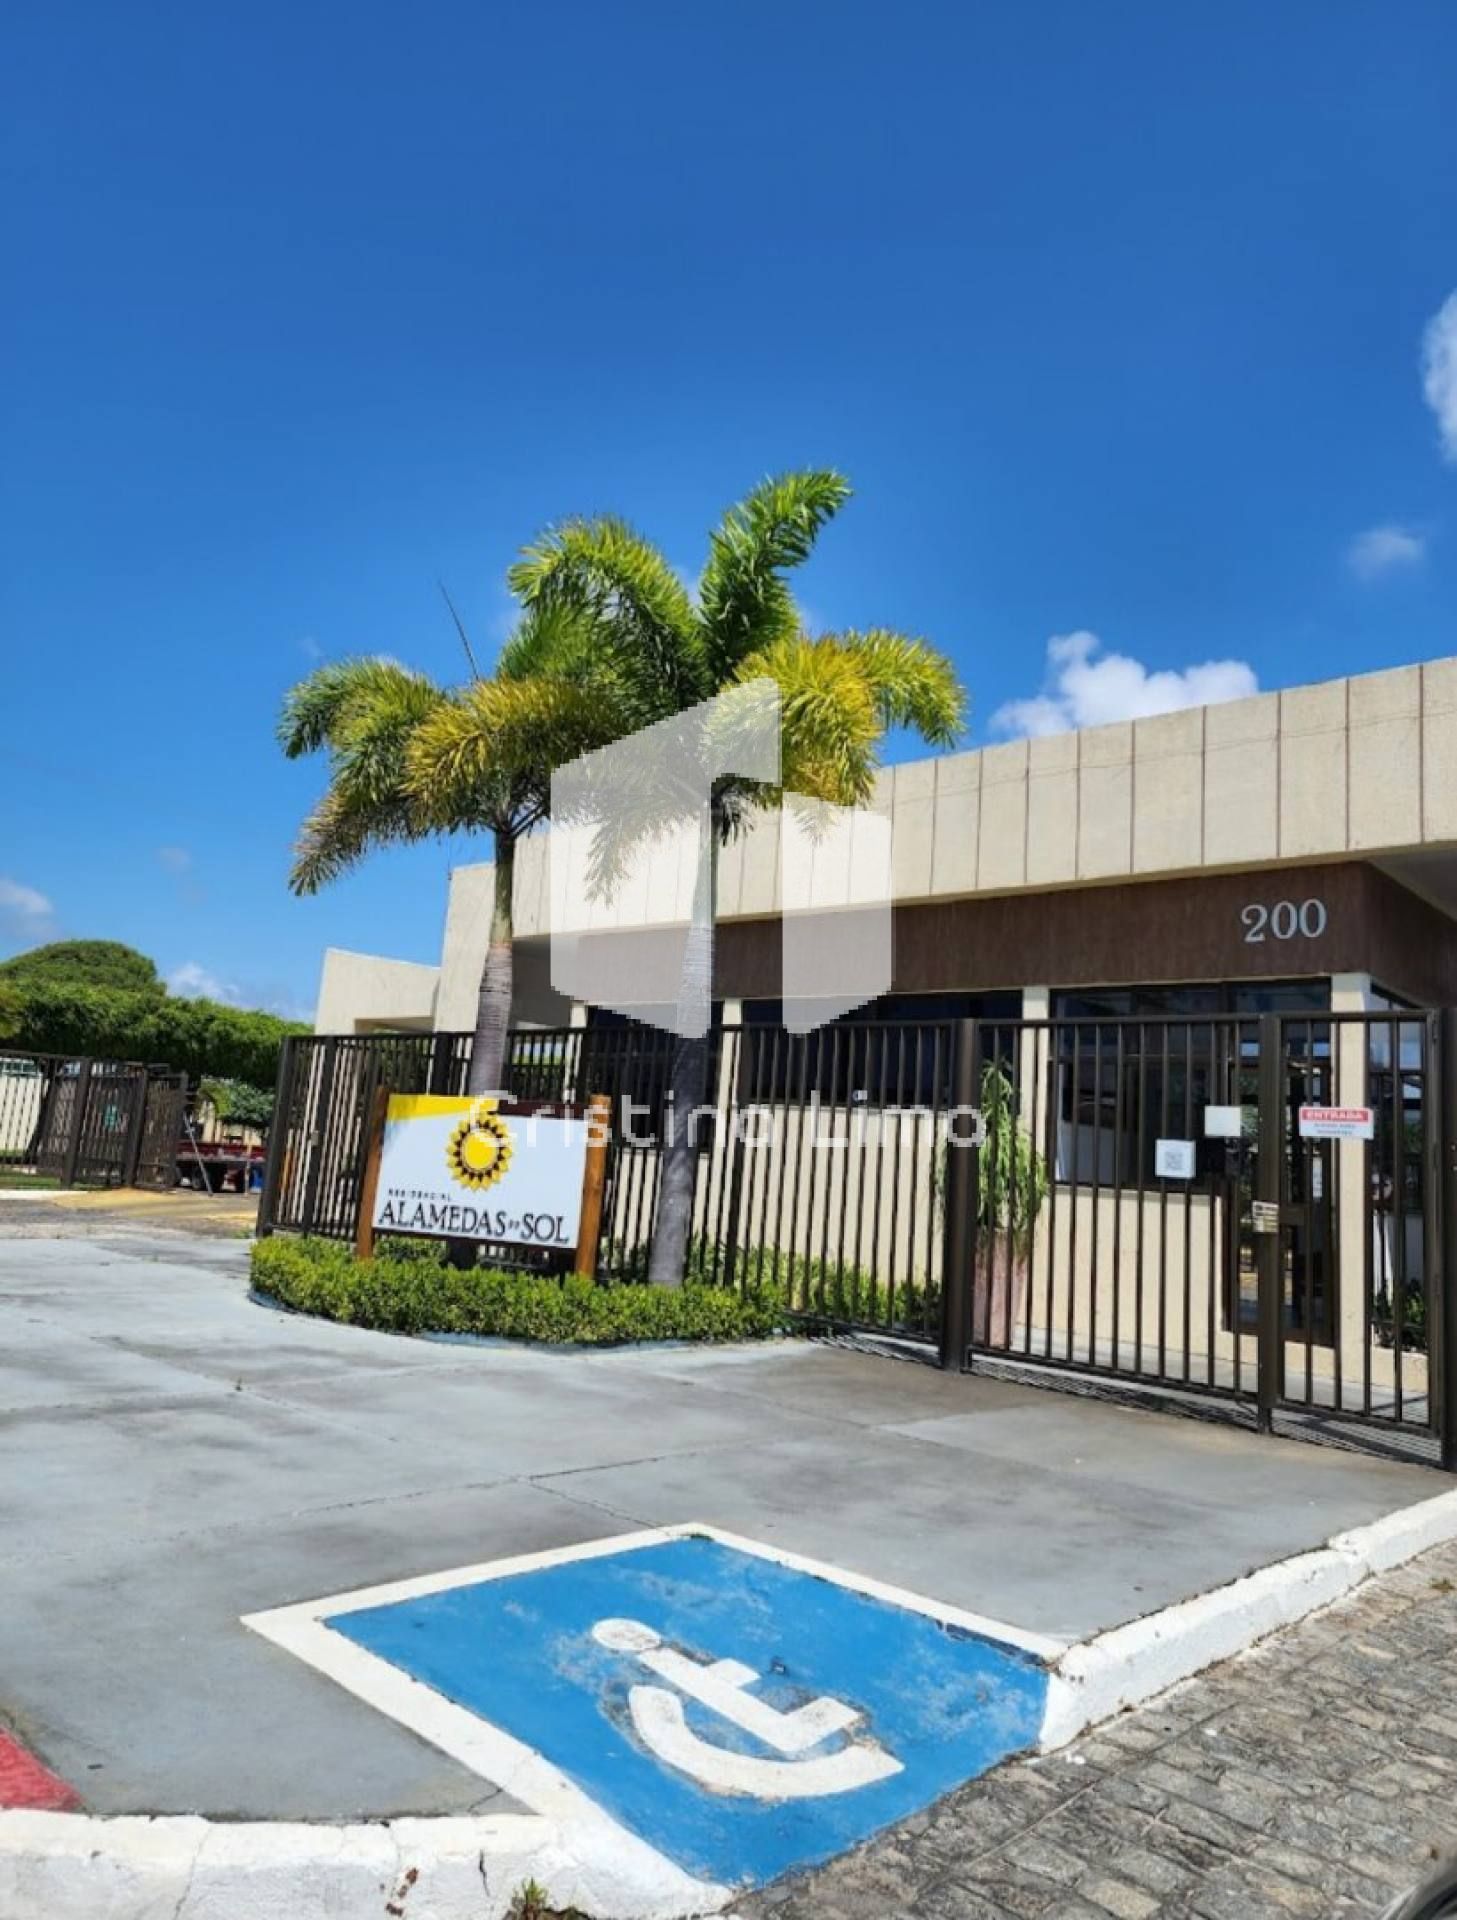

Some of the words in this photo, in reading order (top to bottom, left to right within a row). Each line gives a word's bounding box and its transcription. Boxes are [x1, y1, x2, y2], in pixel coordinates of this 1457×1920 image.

[1241, 899, 1327, 943] 200
[378, 1200, 506, 1237] ALAMEDAS
[520, 1213, 570, 1244] SOL
